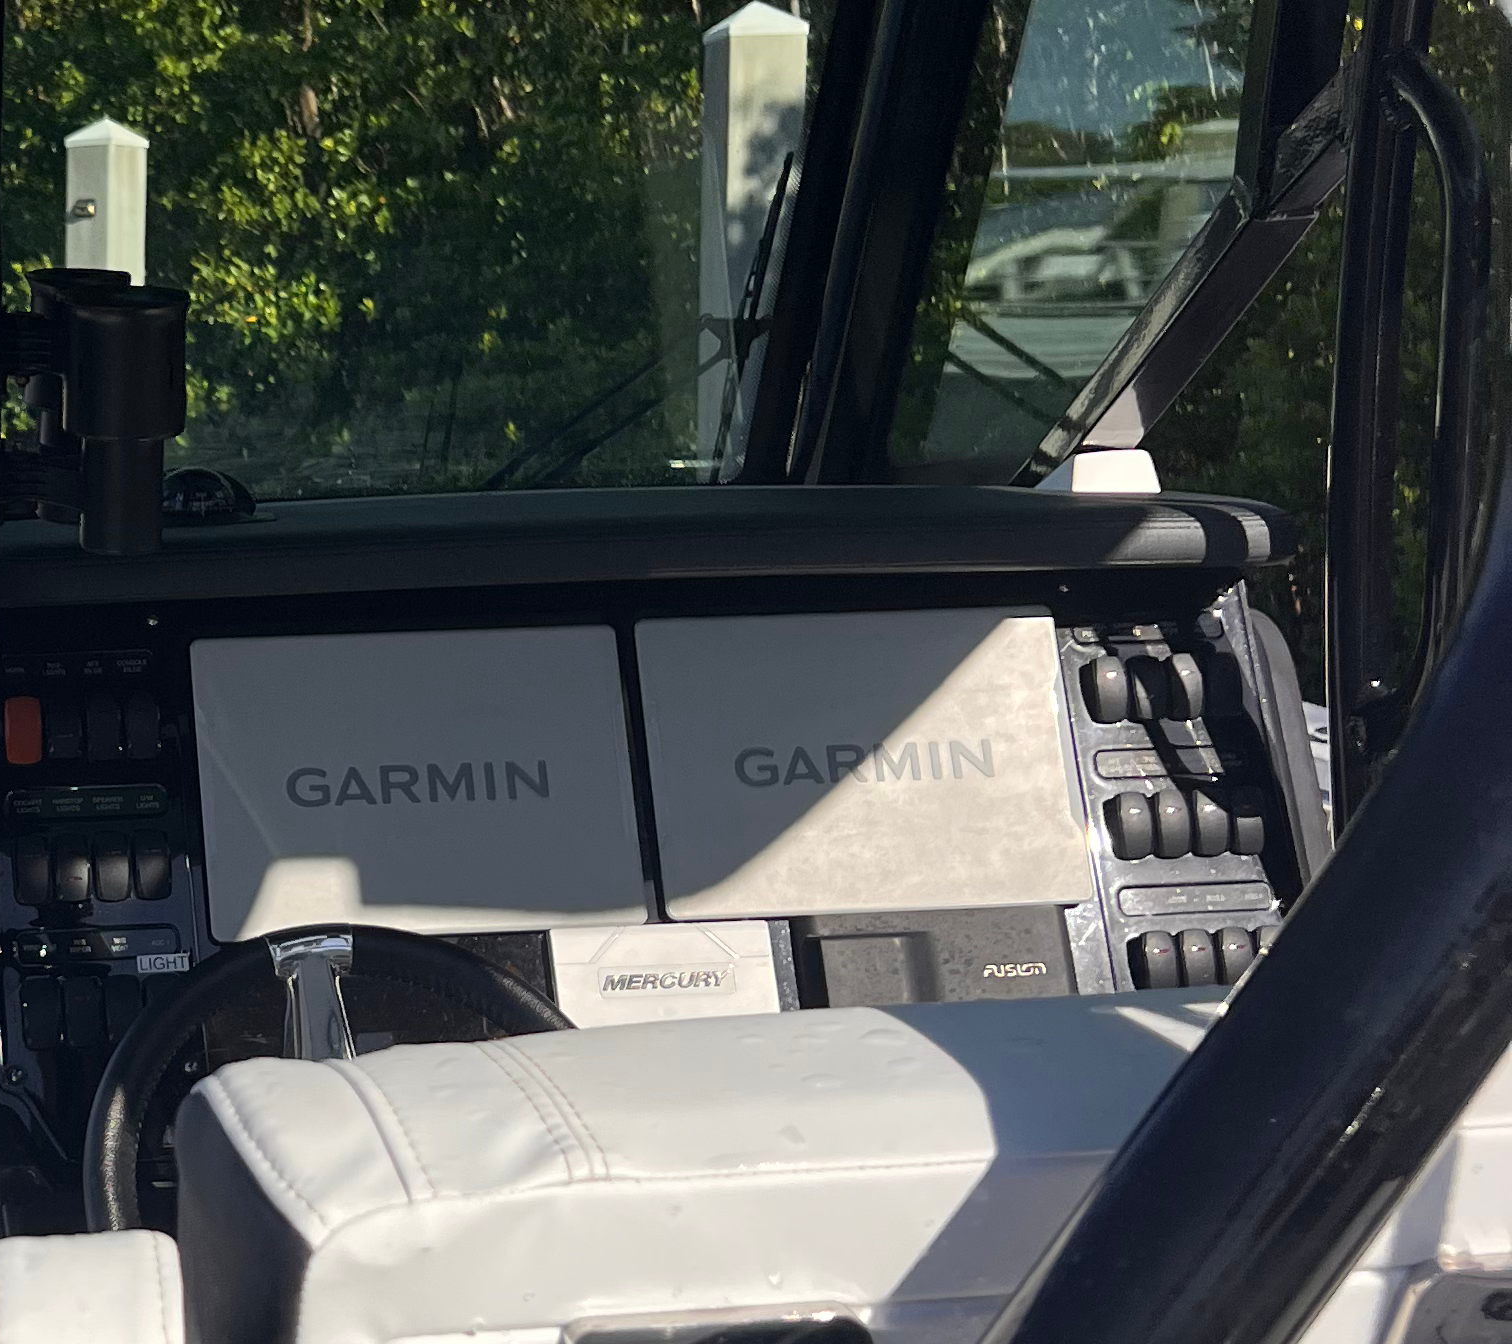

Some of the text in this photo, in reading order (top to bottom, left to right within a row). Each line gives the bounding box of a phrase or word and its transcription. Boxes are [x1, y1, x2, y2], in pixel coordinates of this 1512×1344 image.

[733, 738, 996, 790] GARMIN
[285, 759, 550, 809] GARMIN
[138, 955, 188, 972] LIGHT
[602, 968, 730, 992] MERCURY
